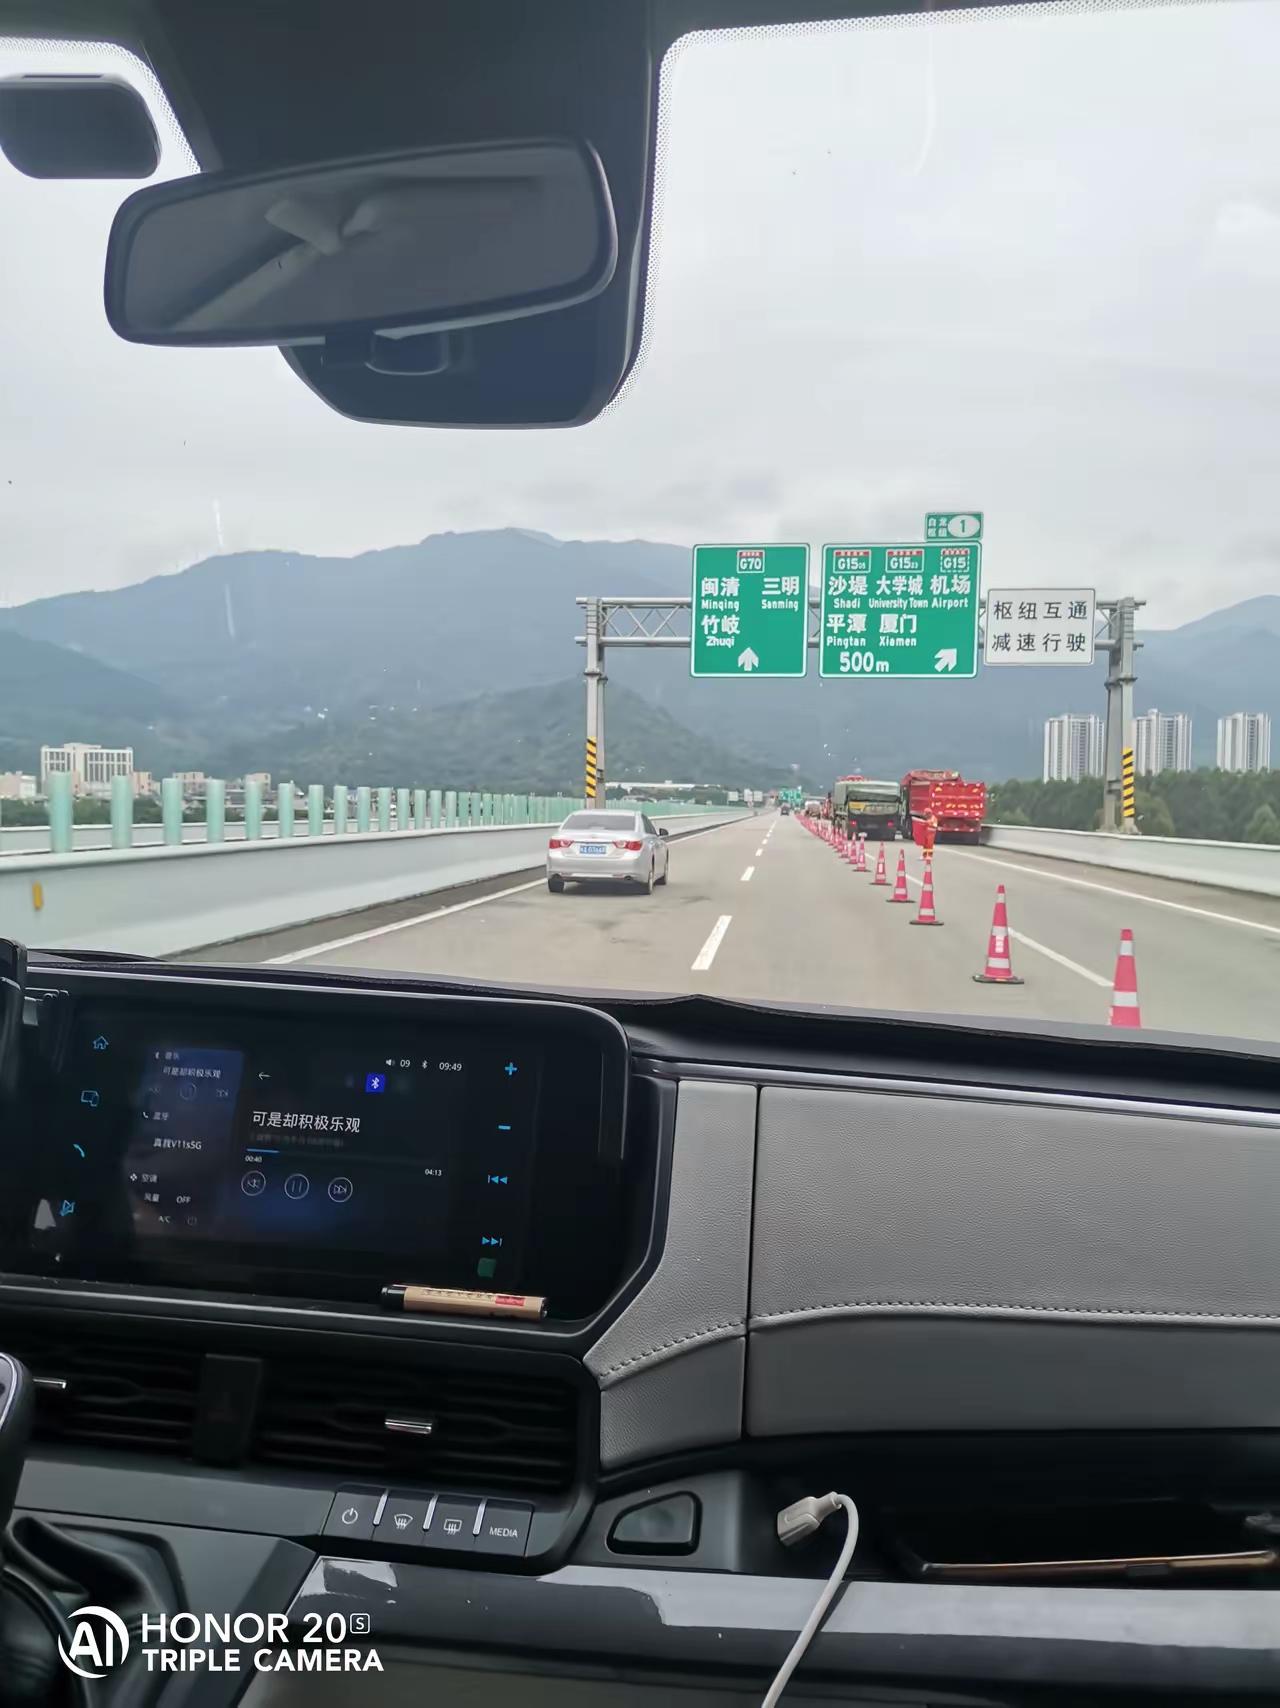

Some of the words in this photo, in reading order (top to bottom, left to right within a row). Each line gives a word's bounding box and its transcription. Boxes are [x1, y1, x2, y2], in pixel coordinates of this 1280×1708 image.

[960, 519, 966, 533] 1
[740, 557, 762, 570] G70
[943, 556, 966, 569] G15
[701, 577, 740, 597] 闽清
[761, 576, 800, 596] 三明
[828, 575, 868, 596] 沙堤
[876, 575, 923, 596] 大学城
[930, 574, 971, 595] 机场
[701, 599, 739, 612] Minqing
[761, 599, 799, 612] Sanming
[833, 598, 861, 609] Shadi
[868, 598, 908, 610] University
[909, 598, 928, 609] Town
[931, 598, 969, 610] Airport
[993, 600, 1088, 620] 枢纽互通
[700, 614, 741, 635] 竹岐
[826, 613, 867, 634] 平潭
[879, 613, 918, 634] 厦门
[706, 635, 735, 648] Zhuqi
[826, 636, 866, 649] Pingtan
[879, 636, 917, 647] Xiamen
[991, 632, 1086, 652] 减速行驶
[400, 1059, 411, 1068] 09
[438, 1061, 463, 1072] 09:49
[253, 1110, 361, 1133] 可是却积极乐观
[424, 1167, 442, 1177] 04:13
[176, 1195, 192, 1204] OFF
[489, 1526, 518, 1538] MEDIA
